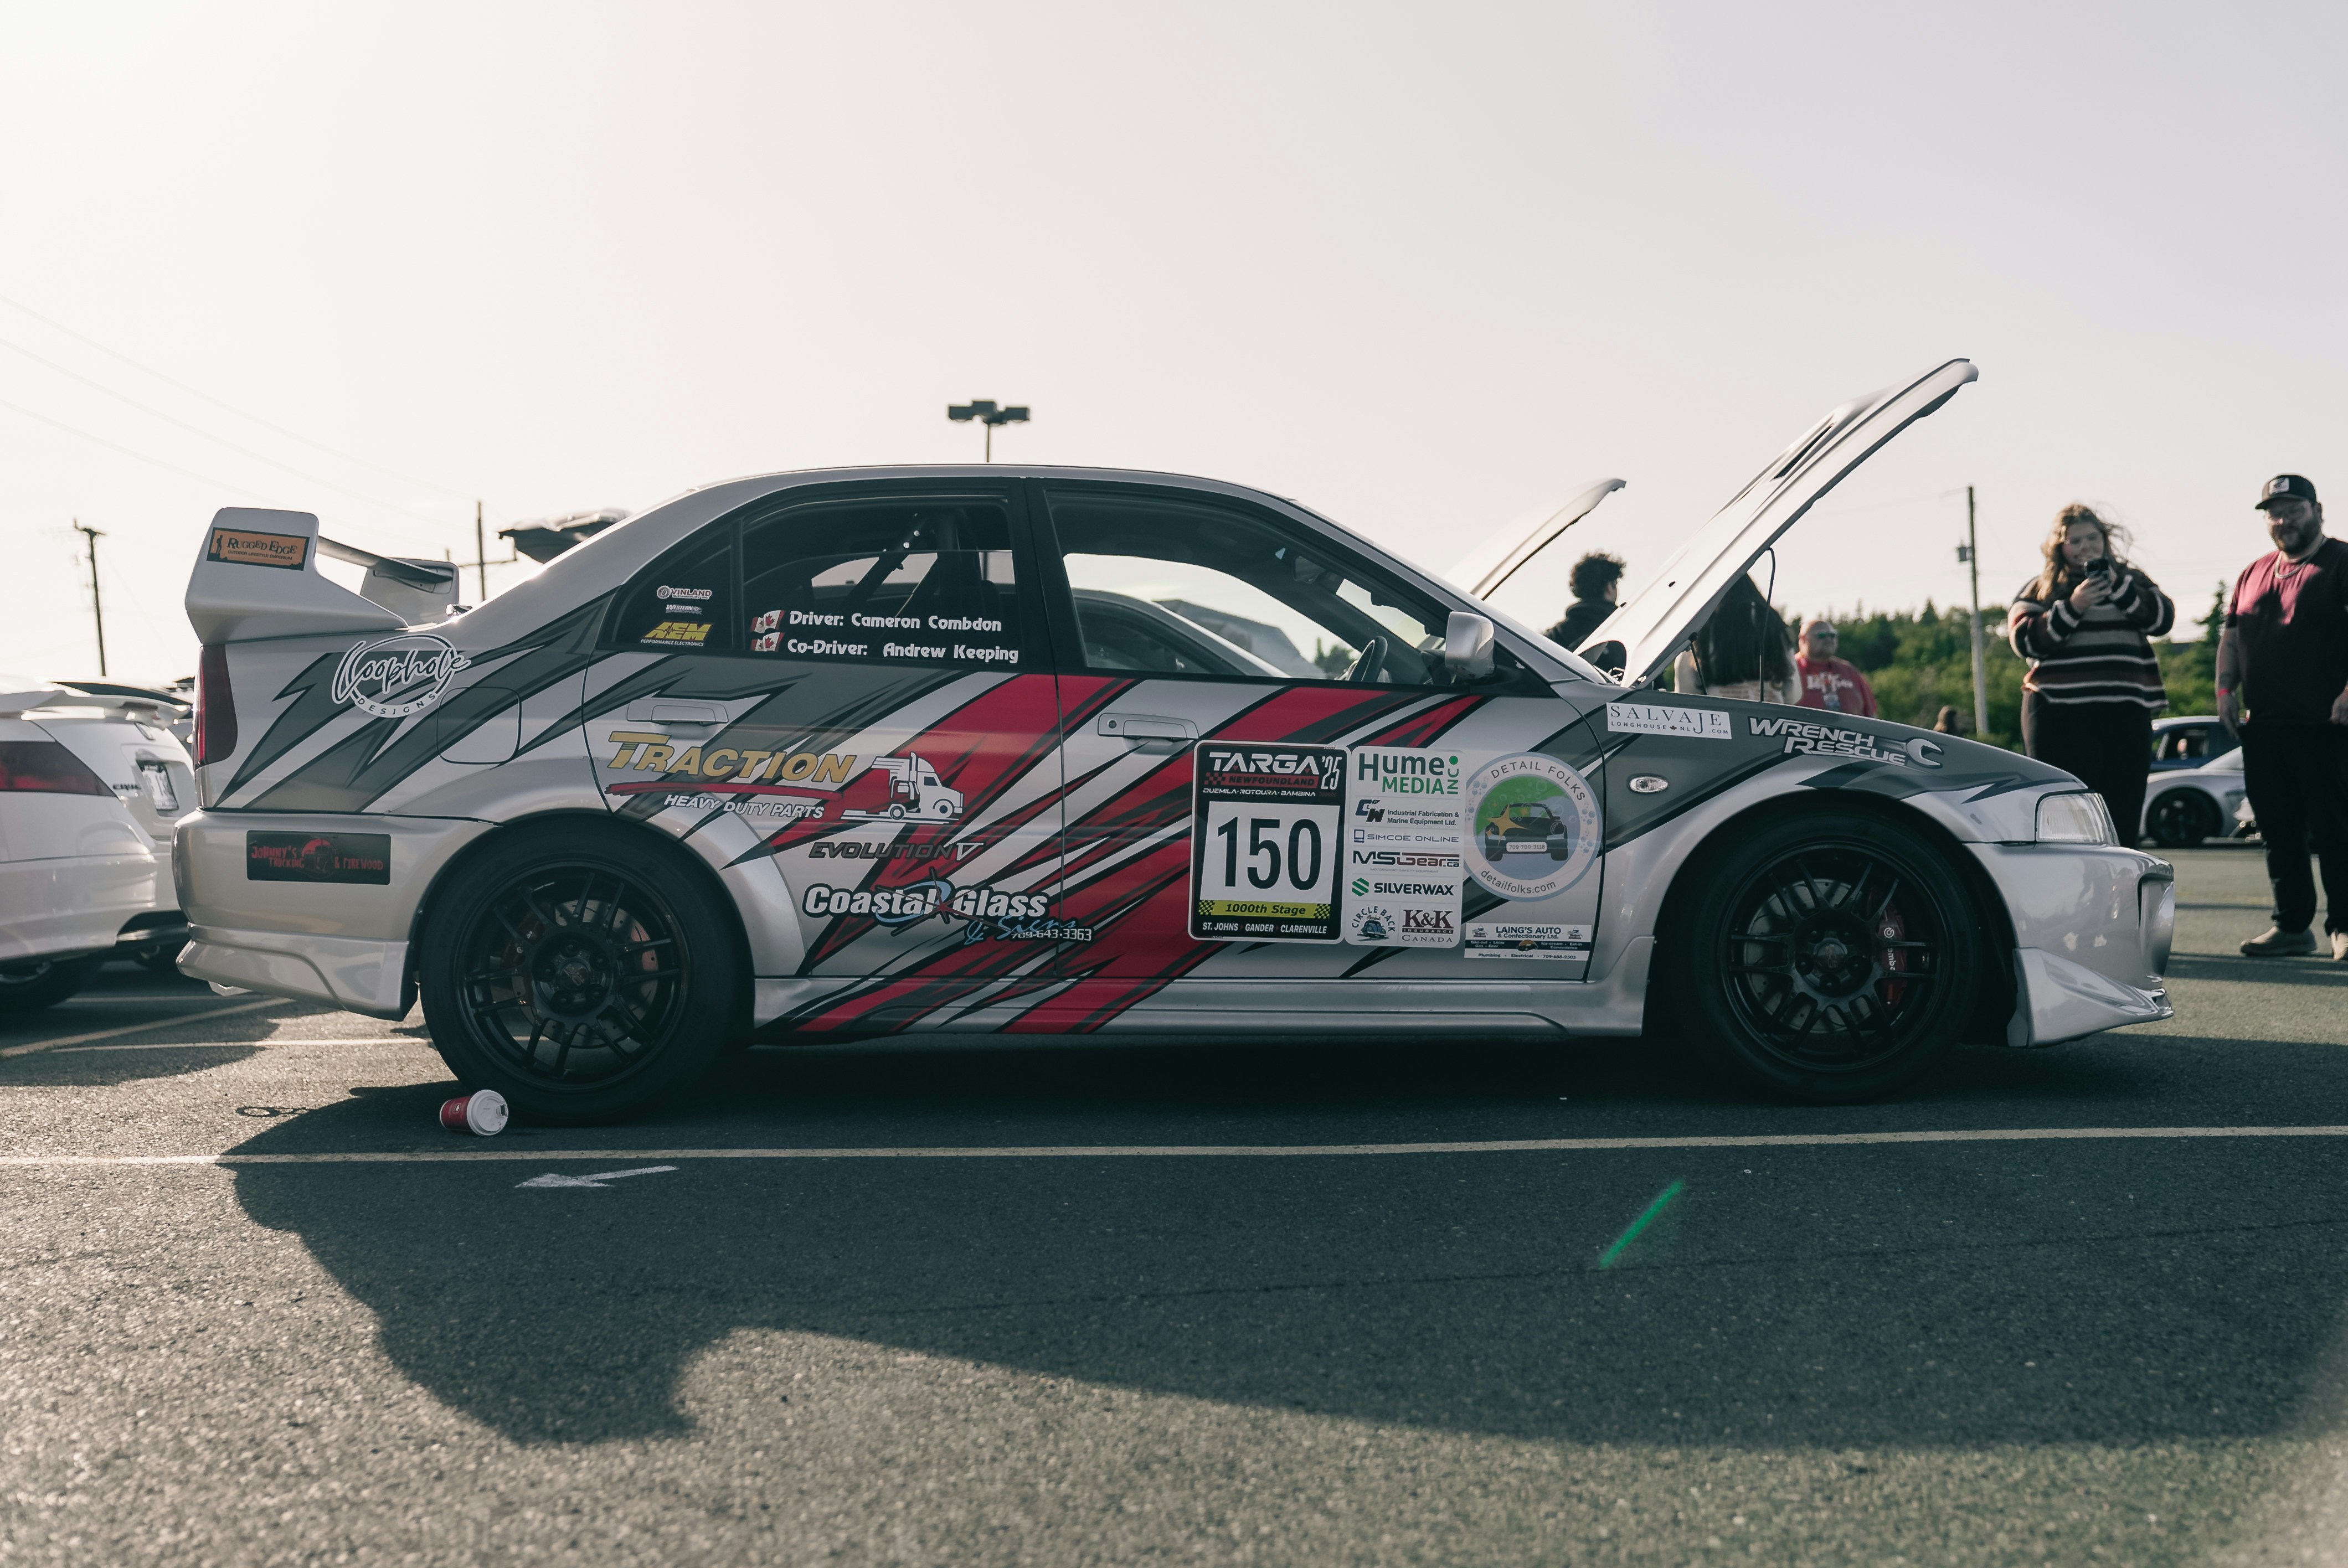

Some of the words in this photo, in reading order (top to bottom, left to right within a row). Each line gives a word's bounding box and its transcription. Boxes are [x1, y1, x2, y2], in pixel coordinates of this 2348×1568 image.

[227, 538, 267, 550] RUGGED
[269, 540, 297, 554] EDGE
[645, 622, 712, 641] AEM
[790, 611, 843, 626] Driver:
[851, 613, 920, 628] Cameron
[928, 616, 1001, 631] Combdon
[787, 639, 868, 656] Co-Driver:
[883, 643, 946, 658] Andrew
[954, 644, 1018, 663] Keeping
[358, 693, 436, 715] DESIGNS
[1610, 705, 1721, 734] SALVAJE
[1611, 721, 1666, 730] LONGHOUSE
[1750, 718, 1875, 747] WRENCH
[608, 731, 856, 783] TRACTION
[1784, 736, 1906, 766] RESCUE
[1209, 752, 1320, 775] TARGA
[1358, 753, 1445, 781] Hume
[1228, 776, 1315, 786] NEWFOUNDLAND
[1382, 776, 1444, 795] MEDIA
[1491, 761, 1541, 778] DETAIL
[1548, 765, 1585, 801] FOLKS
[664, 794, 723, 809] HEAVY
[723, 801, 769, 816] DUTY
[771, 804, 825, 819] PARTS
[809, 842, 953, 859] EVOLUTION
[1218, 816, 1322, 891] 150
[269, 858, 304, 869] TRUCKING
[334, 857, 340, 869] &
[1374, 882, 1454, 896] SILVERWAX
[1481, 870, 1556, 894] detailfolks.com
[805, 886, 937, 915] Coastal
[952, 889, 1047, 917] Glass
[1226, 903, 1268, 914] 1000th
[1271, 905, 1306, 916] Stage
[1214, 922, 1239, 931] JOHNS
[1245, 923, 1274, 932] GANDER
[1280, 924, 1327, 933] CLARENVILLE
[1351, 906, 1378, 929] CIRCLE
[1379, 909, 1396, 932] BACK
[1402, 909, 1454, 929] K&K
[1402, 935, 1453, 943] CANADA
